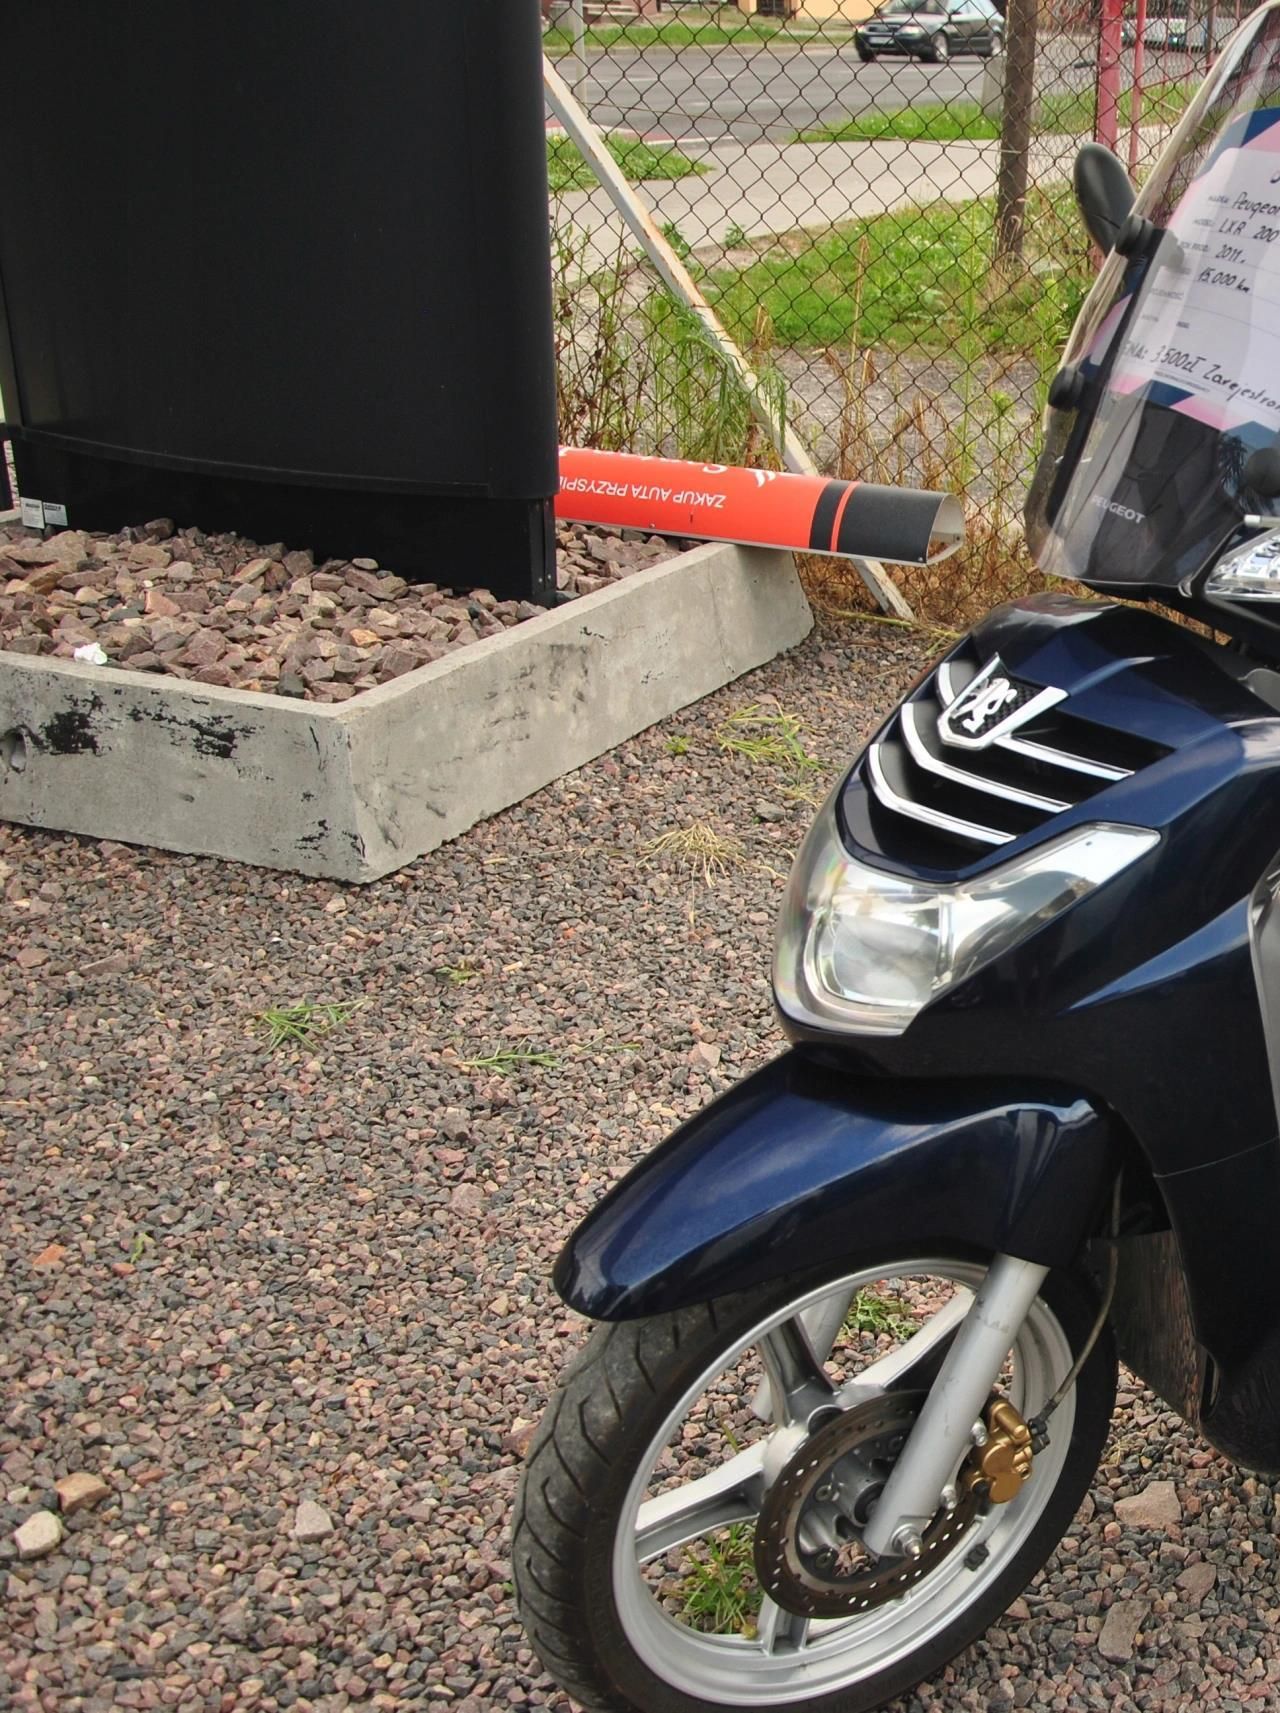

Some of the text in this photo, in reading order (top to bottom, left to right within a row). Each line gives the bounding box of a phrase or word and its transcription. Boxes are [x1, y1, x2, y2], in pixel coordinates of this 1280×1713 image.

[1218, 217, 1247, 236] LXR
[1252, 225, 1280, 243] 200
[631, 484, 673, 503] AUTA
[672, 490, 727, 509] ZAKUP
[1090, 494, 1146, 524] PEUGEOT
